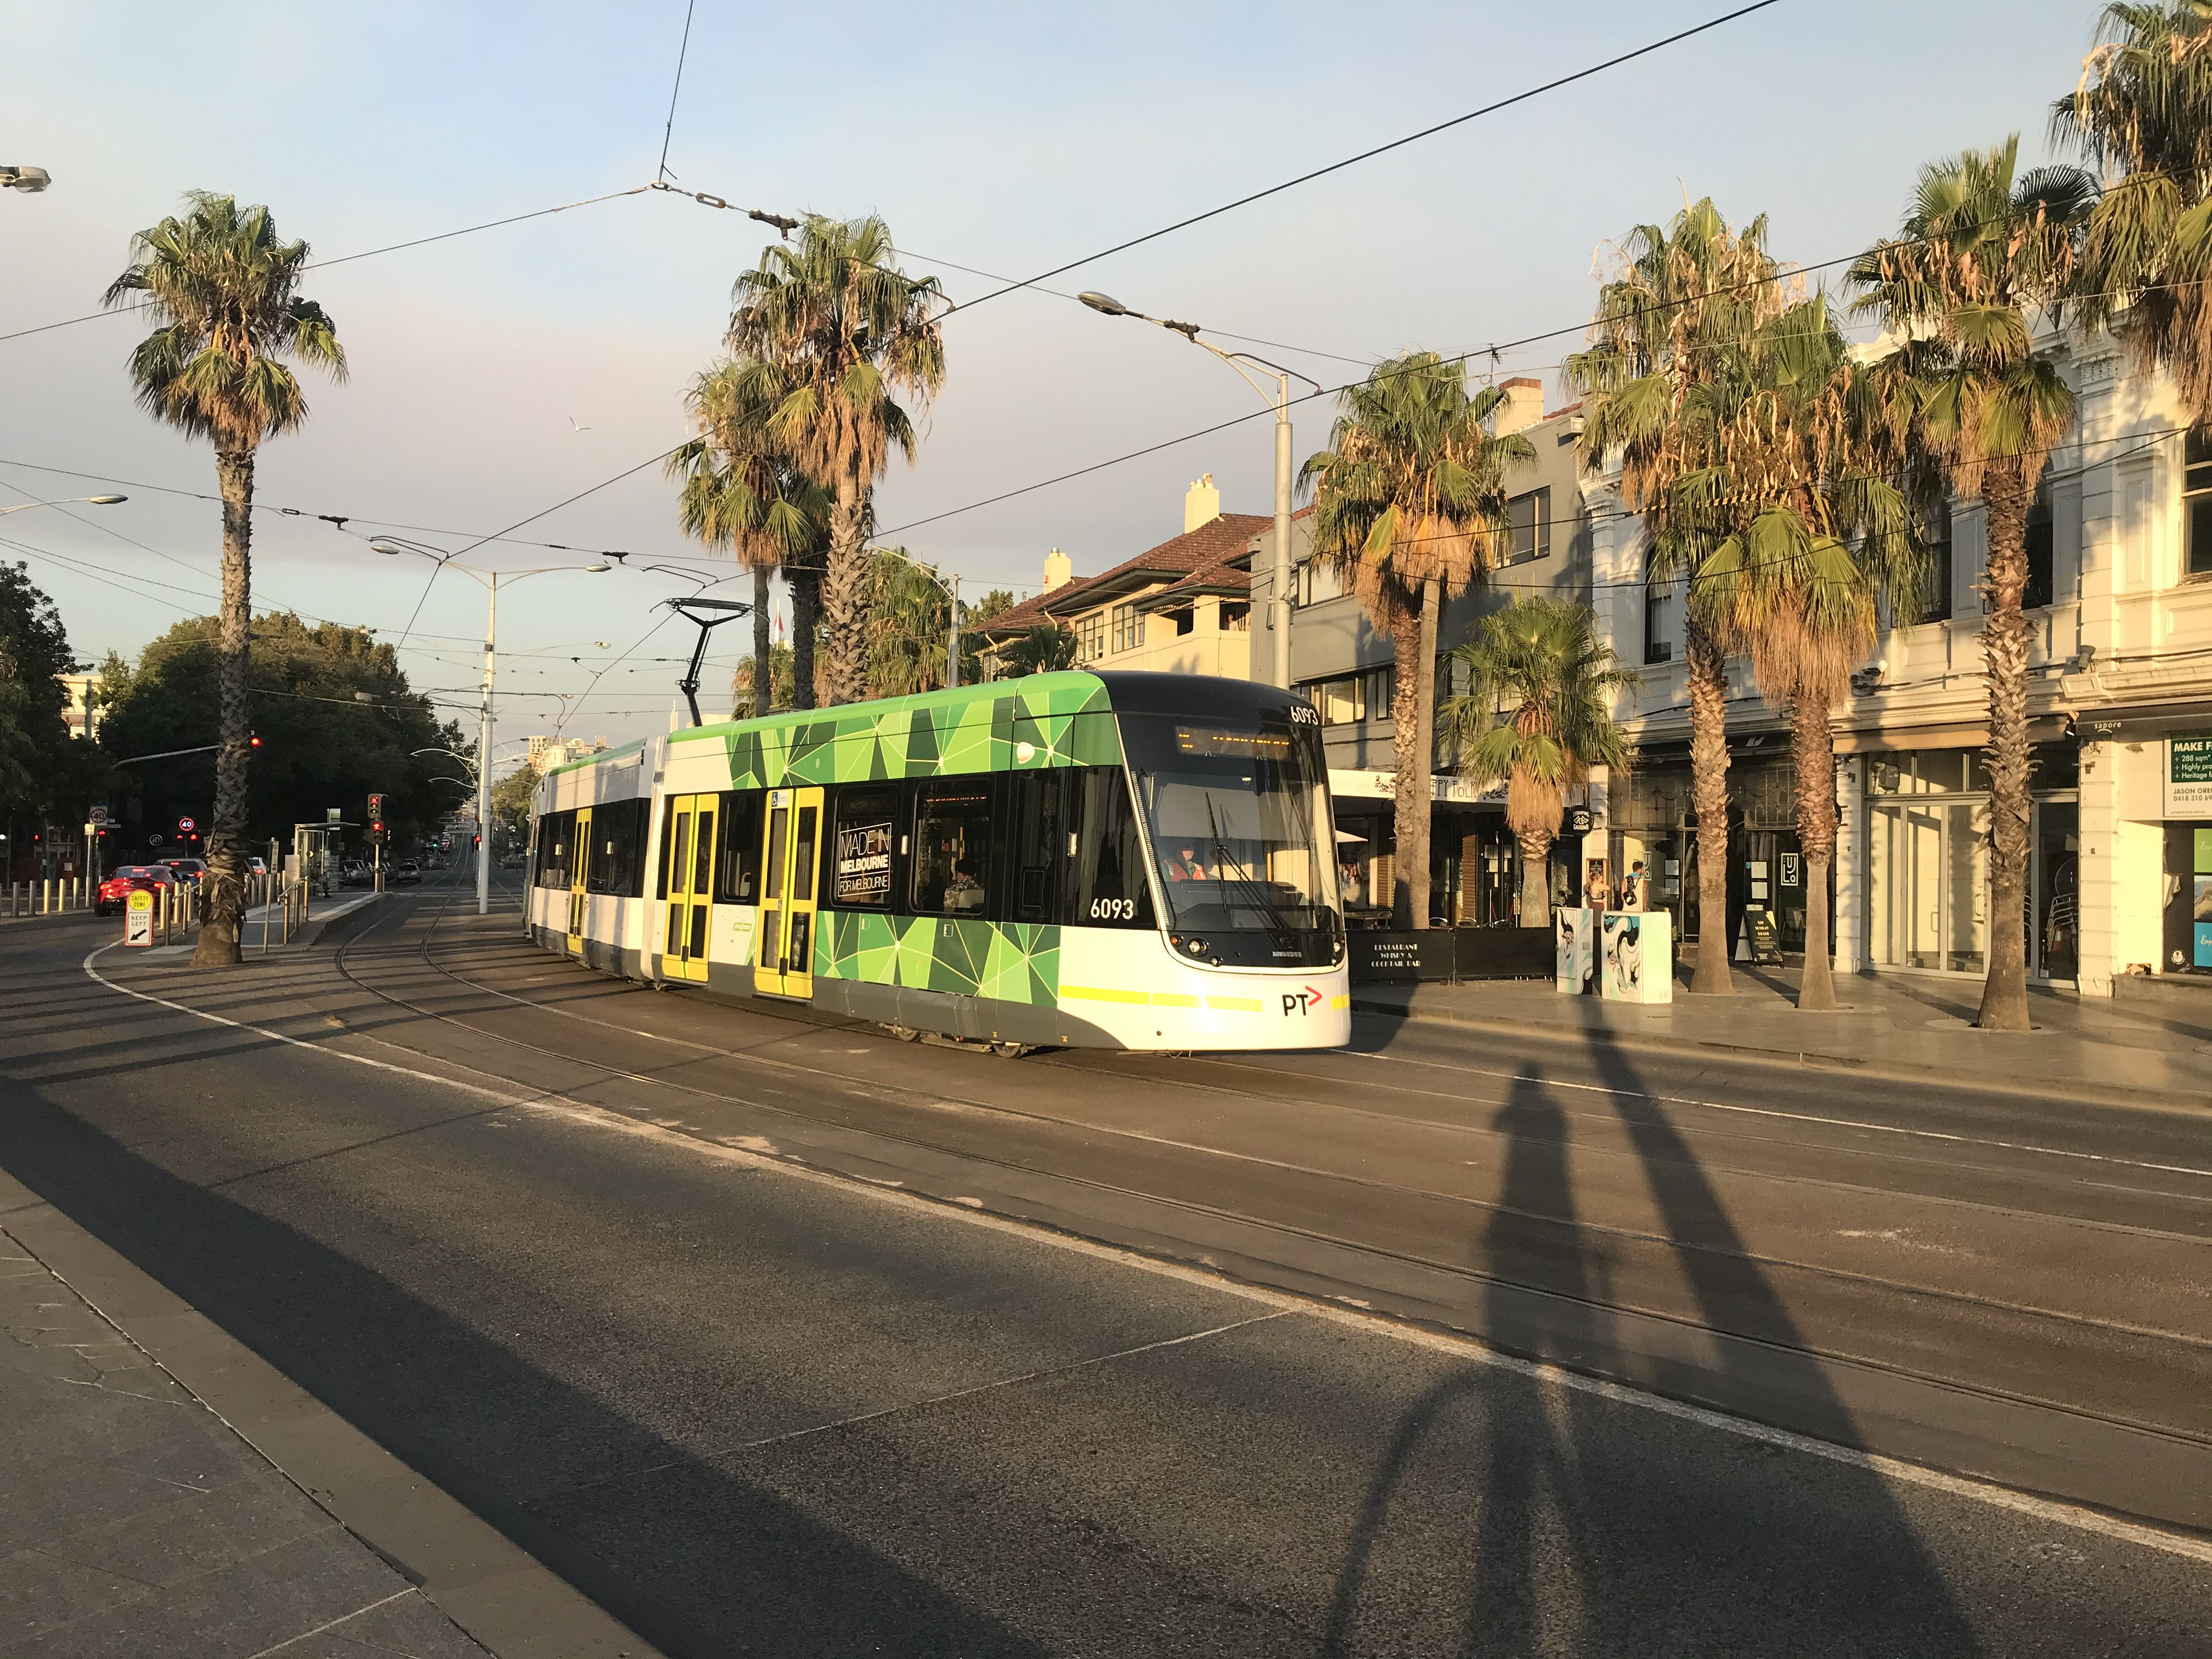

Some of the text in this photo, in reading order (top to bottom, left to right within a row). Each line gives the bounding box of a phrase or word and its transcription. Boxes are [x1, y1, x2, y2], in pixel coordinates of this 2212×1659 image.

[1290, 706, 1318, 725] 6093
[2094, 722, 2121, 731] sapore
[2174, 741, 2212, 752] MAKE F
[2181, 763, 2201, 771] Highly
[840, 827, 890, 858] MADE IN
[840, 854, 889, 874] MELBOURNE
[839, 875, 888, 892] FOR MELBOURNE
[1090, 898, 1134, 919] 6093
